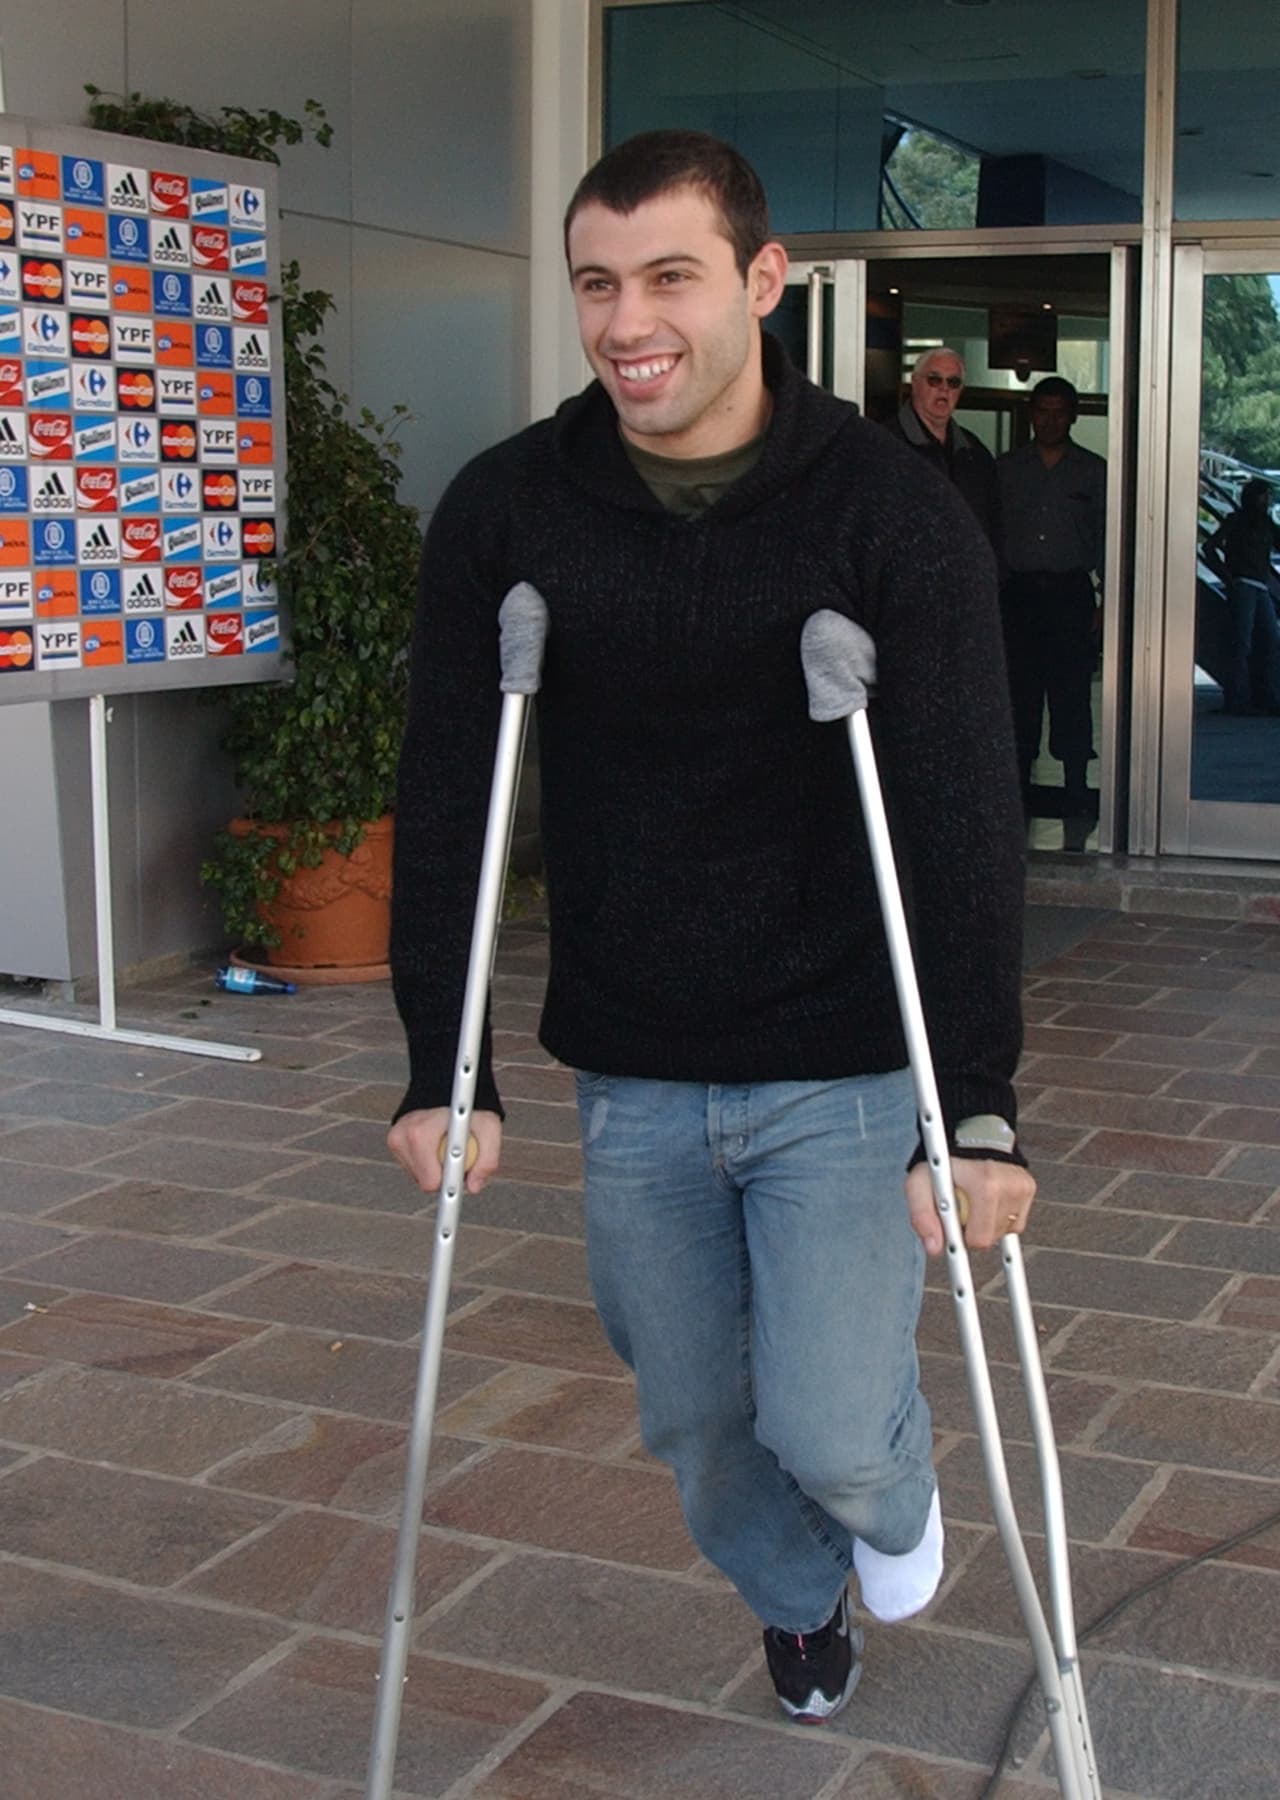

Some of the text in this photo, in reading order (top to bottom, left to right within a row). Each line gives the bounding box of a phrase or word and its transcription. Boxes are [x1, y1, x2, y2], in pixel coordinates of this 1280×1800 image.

[111, 194, 146, 209] adidas
[22, 211, 59, 230] YPF
[154, 248, 188, 263] adidas
[70, 270, 107, 288] YPF
[196, 303, 228, 316] adidas
[117, 326, 151, 342] YPF
[237, 354, 268, 367] adidas
[161, 380, 193, 394] YPF
[203, 430, 234, 444] YPF
[242, 479, 272, 492] YPF
[33, 495, 73, 509] adidas
[82, 548, 118, 560] adidas
[127, 597, 161, 609] adidas
[41, 632, 78, 649] YPF
[170, 643, 203, 656] adidas
